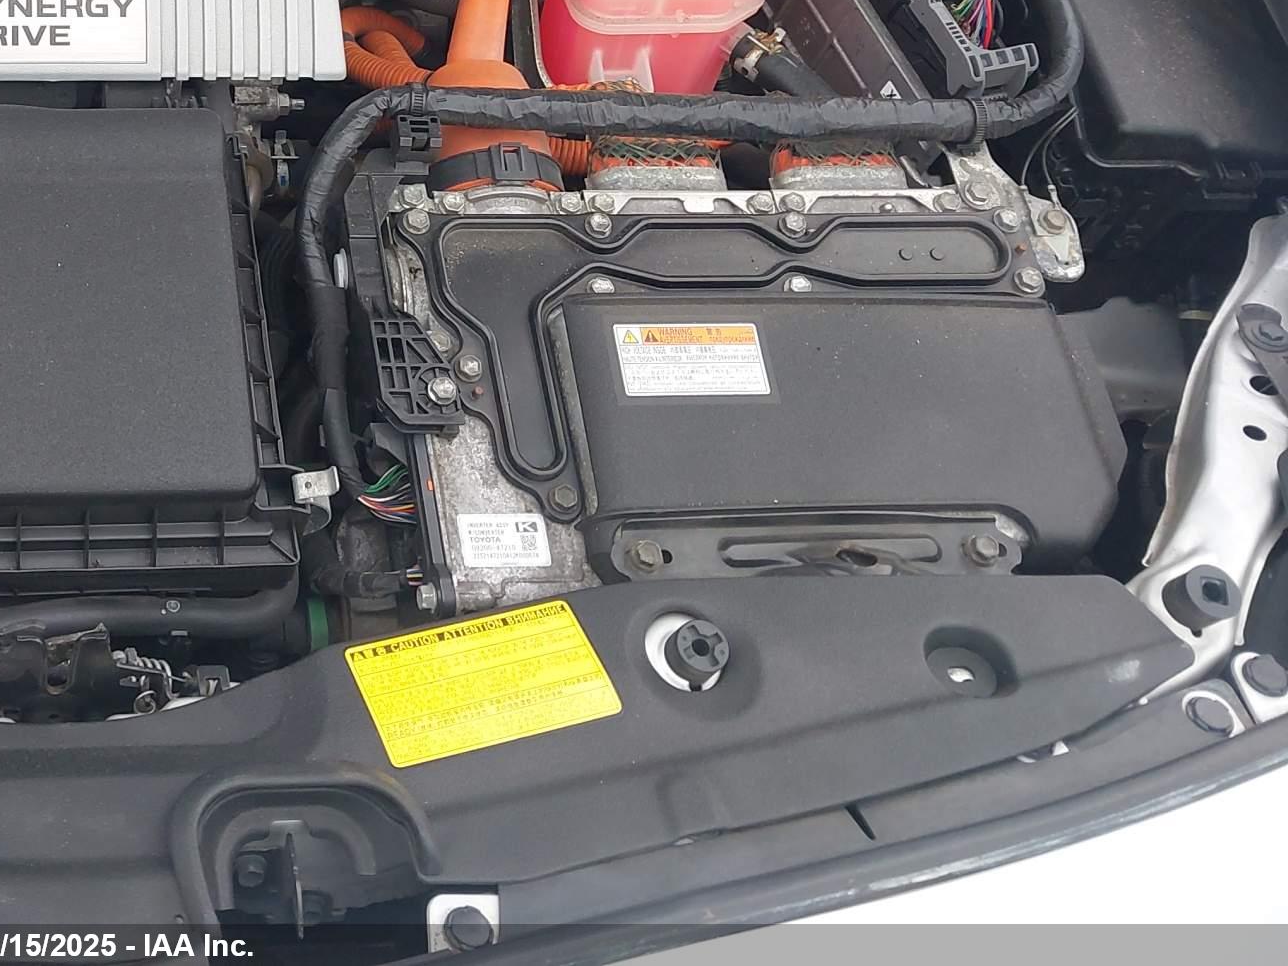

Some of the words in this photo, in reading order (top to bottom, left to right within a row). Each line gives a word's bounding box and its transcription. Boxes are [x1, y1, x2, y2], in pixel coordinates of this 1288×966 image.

[469, 536, 502, 544] TOYOTA
[390, 633, 439, 652] CAUTION
[443, 619, 504, 641] ATTENTION
[506, 605, 566, 625] ВНИМАНИЕ
